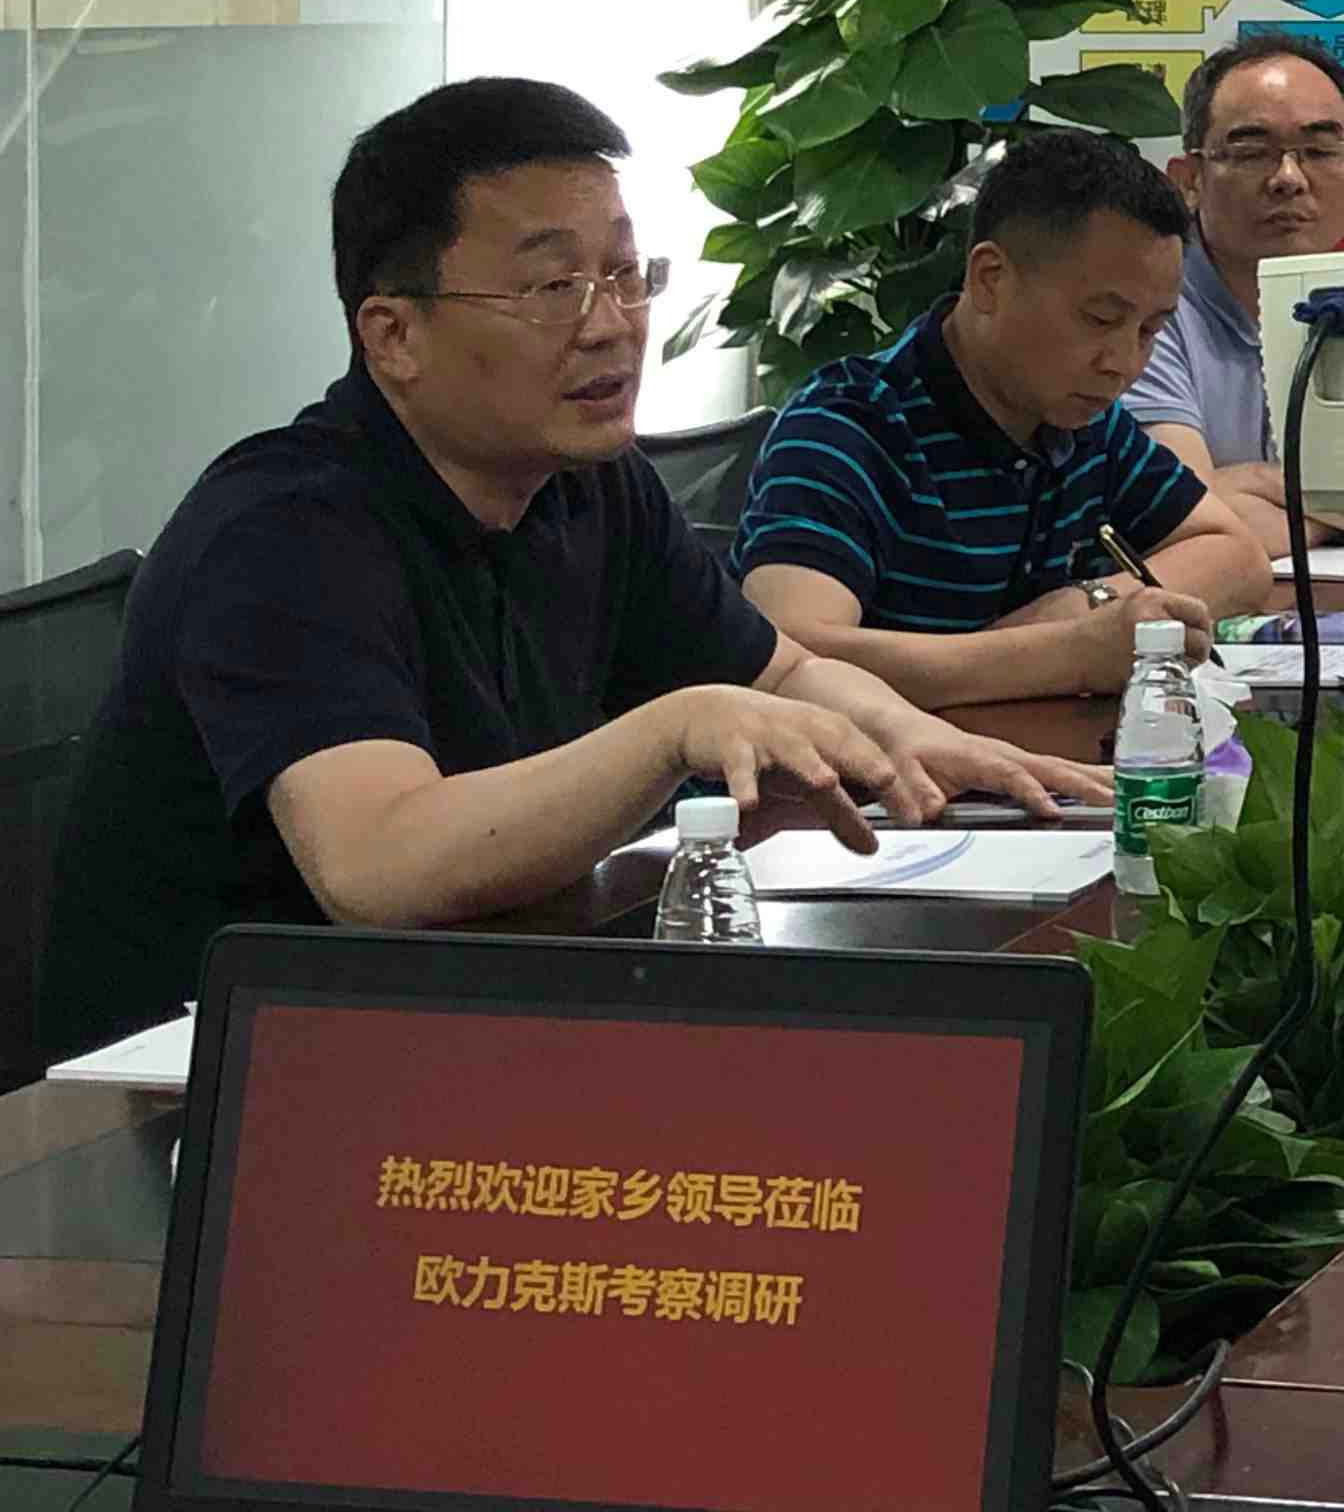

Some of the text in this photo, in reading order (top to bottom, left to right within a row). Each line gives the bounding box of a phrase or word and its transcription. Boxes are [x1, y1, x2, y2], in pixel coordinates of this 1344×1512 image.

[375, 1154, 865, 1234] 热烈欢迎家乡领导莅临
[413, 1254, 805, 1327] 欧力克斯考察调研
